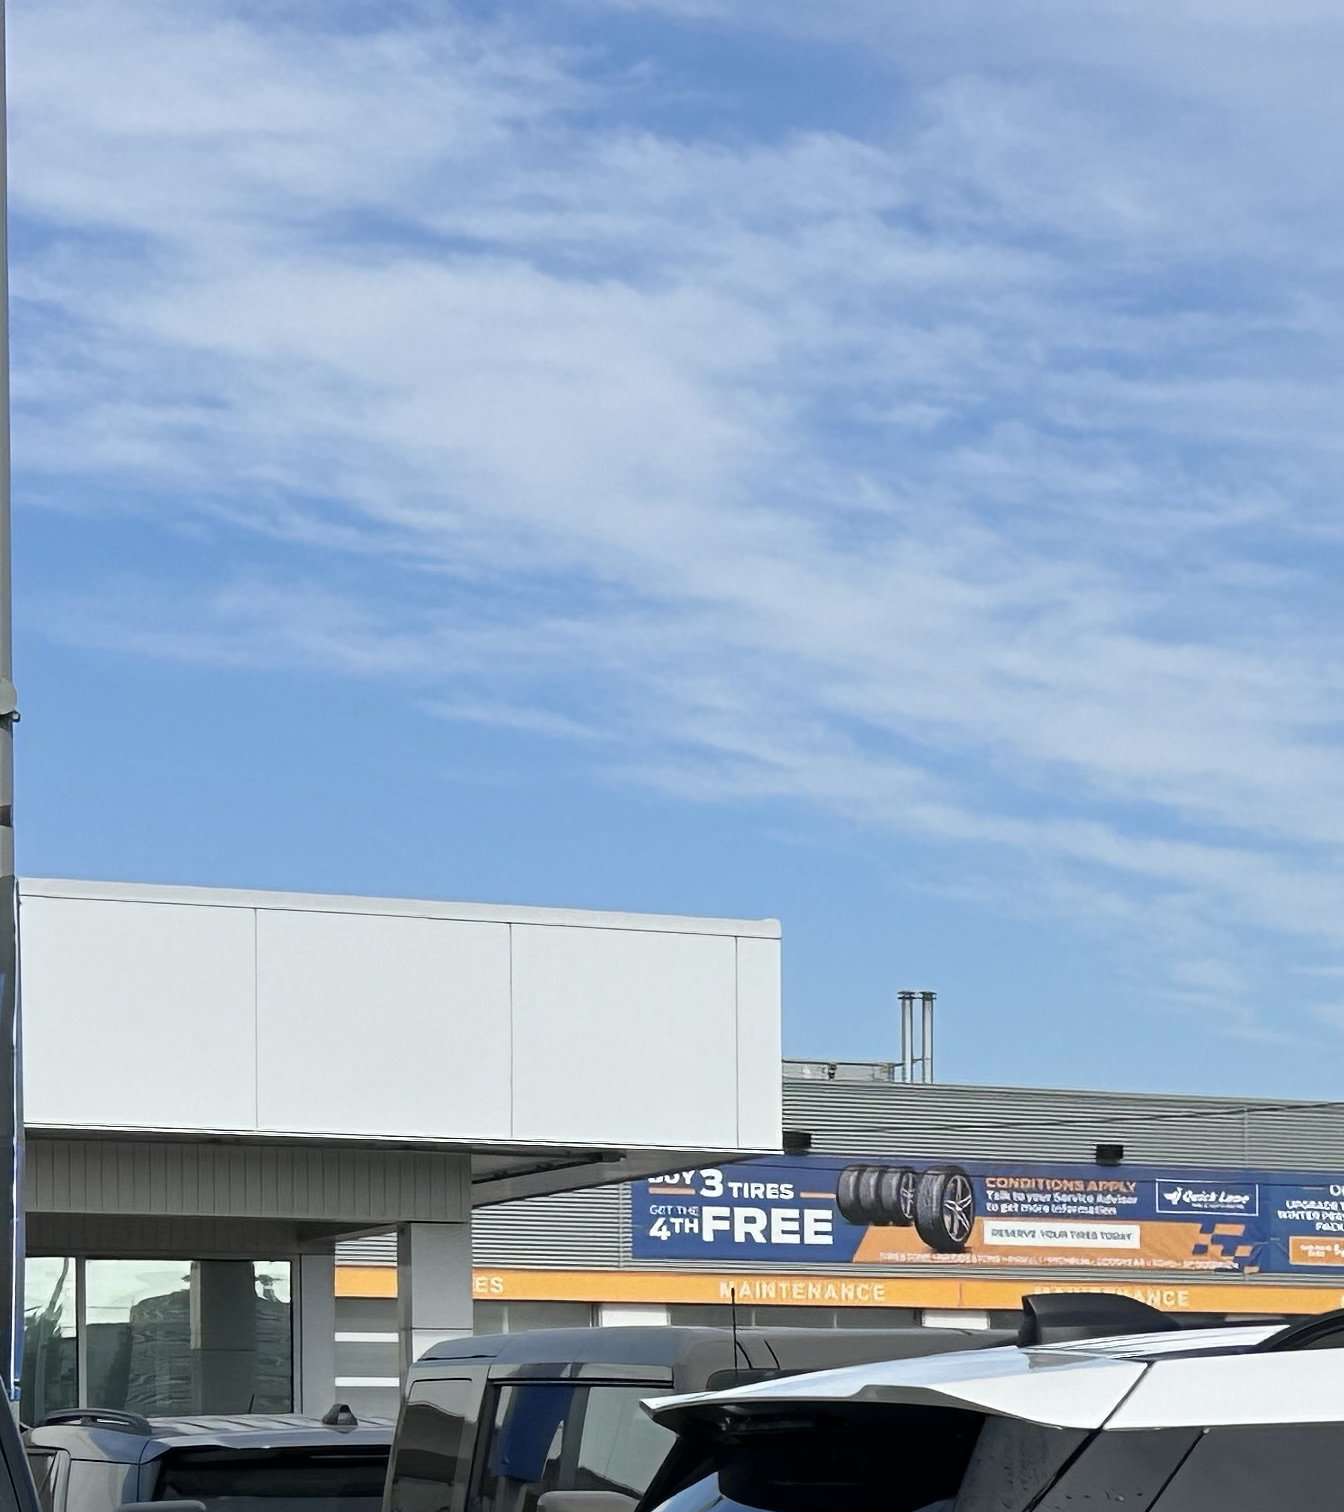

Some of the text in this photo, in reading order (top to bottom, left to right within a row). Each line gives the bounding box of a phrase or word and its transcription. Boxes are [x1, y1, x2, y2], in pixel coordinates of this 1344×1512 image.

[700, 1168, 724, 1197] 3
[728, 1182, 795, 1200] TIRES
[985, 1177, 1137, 1193] CONDITIONS APPLY
[1026, 1193, 1052, 1204] your
[649, 1204, 673, 1215] GET
[648, 1206, 834, 1245] 4TH FREE
[719, 1279, 887, 1302] MAINTENANCE
